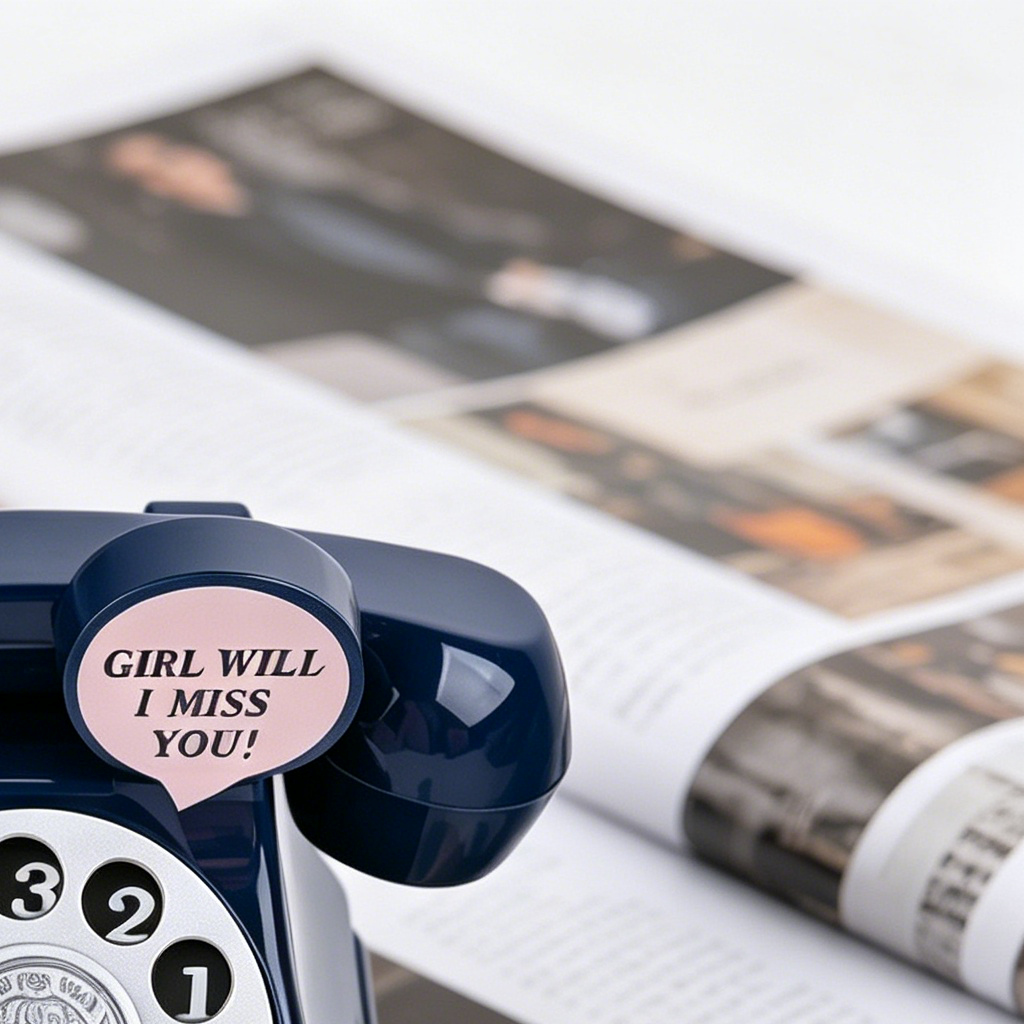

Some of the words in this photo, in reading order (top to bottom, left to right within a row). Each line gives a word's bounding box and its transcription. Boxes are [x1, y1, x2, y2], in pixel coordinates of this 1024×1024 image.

[103, 649, 205, 678] GIRL
[217, 648, 326, 678] WILL
[134, 688, 154, 718] I
[166, 688, 271, 718] MISS
[152, 728, 259, 760] YOU!
[11, 862, 60, 918] 3
[106, 886, 156, 943] 2
[176, 966, 213, 1021] 1
